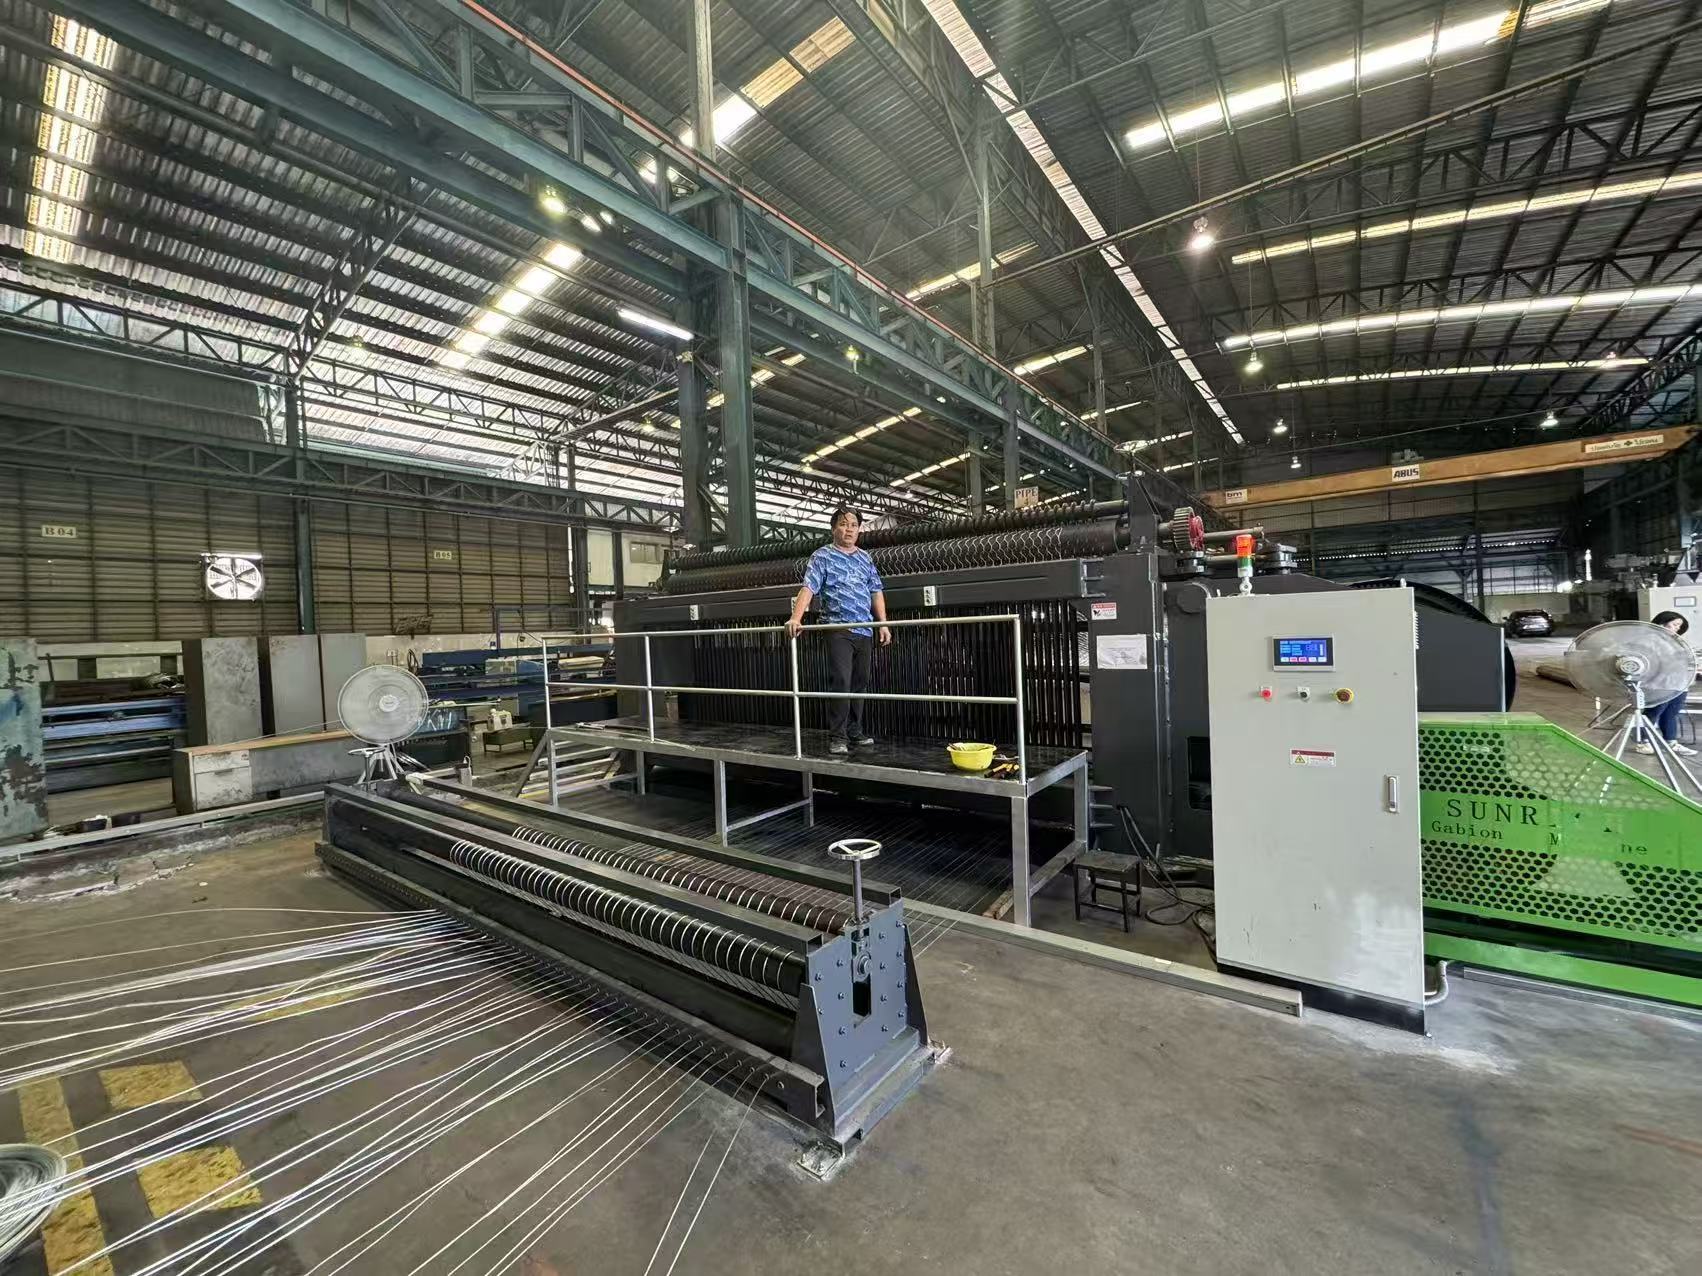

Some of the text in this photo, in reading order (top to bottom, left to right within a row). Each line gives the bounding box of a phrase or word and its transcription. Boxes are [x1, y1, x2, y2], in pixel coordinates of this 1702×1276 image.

[1393, 468, 1419, 478] ABUS
[1016, 489, 1037, 498] PIPE
[1432, 821, 1503, 840] Gabion
